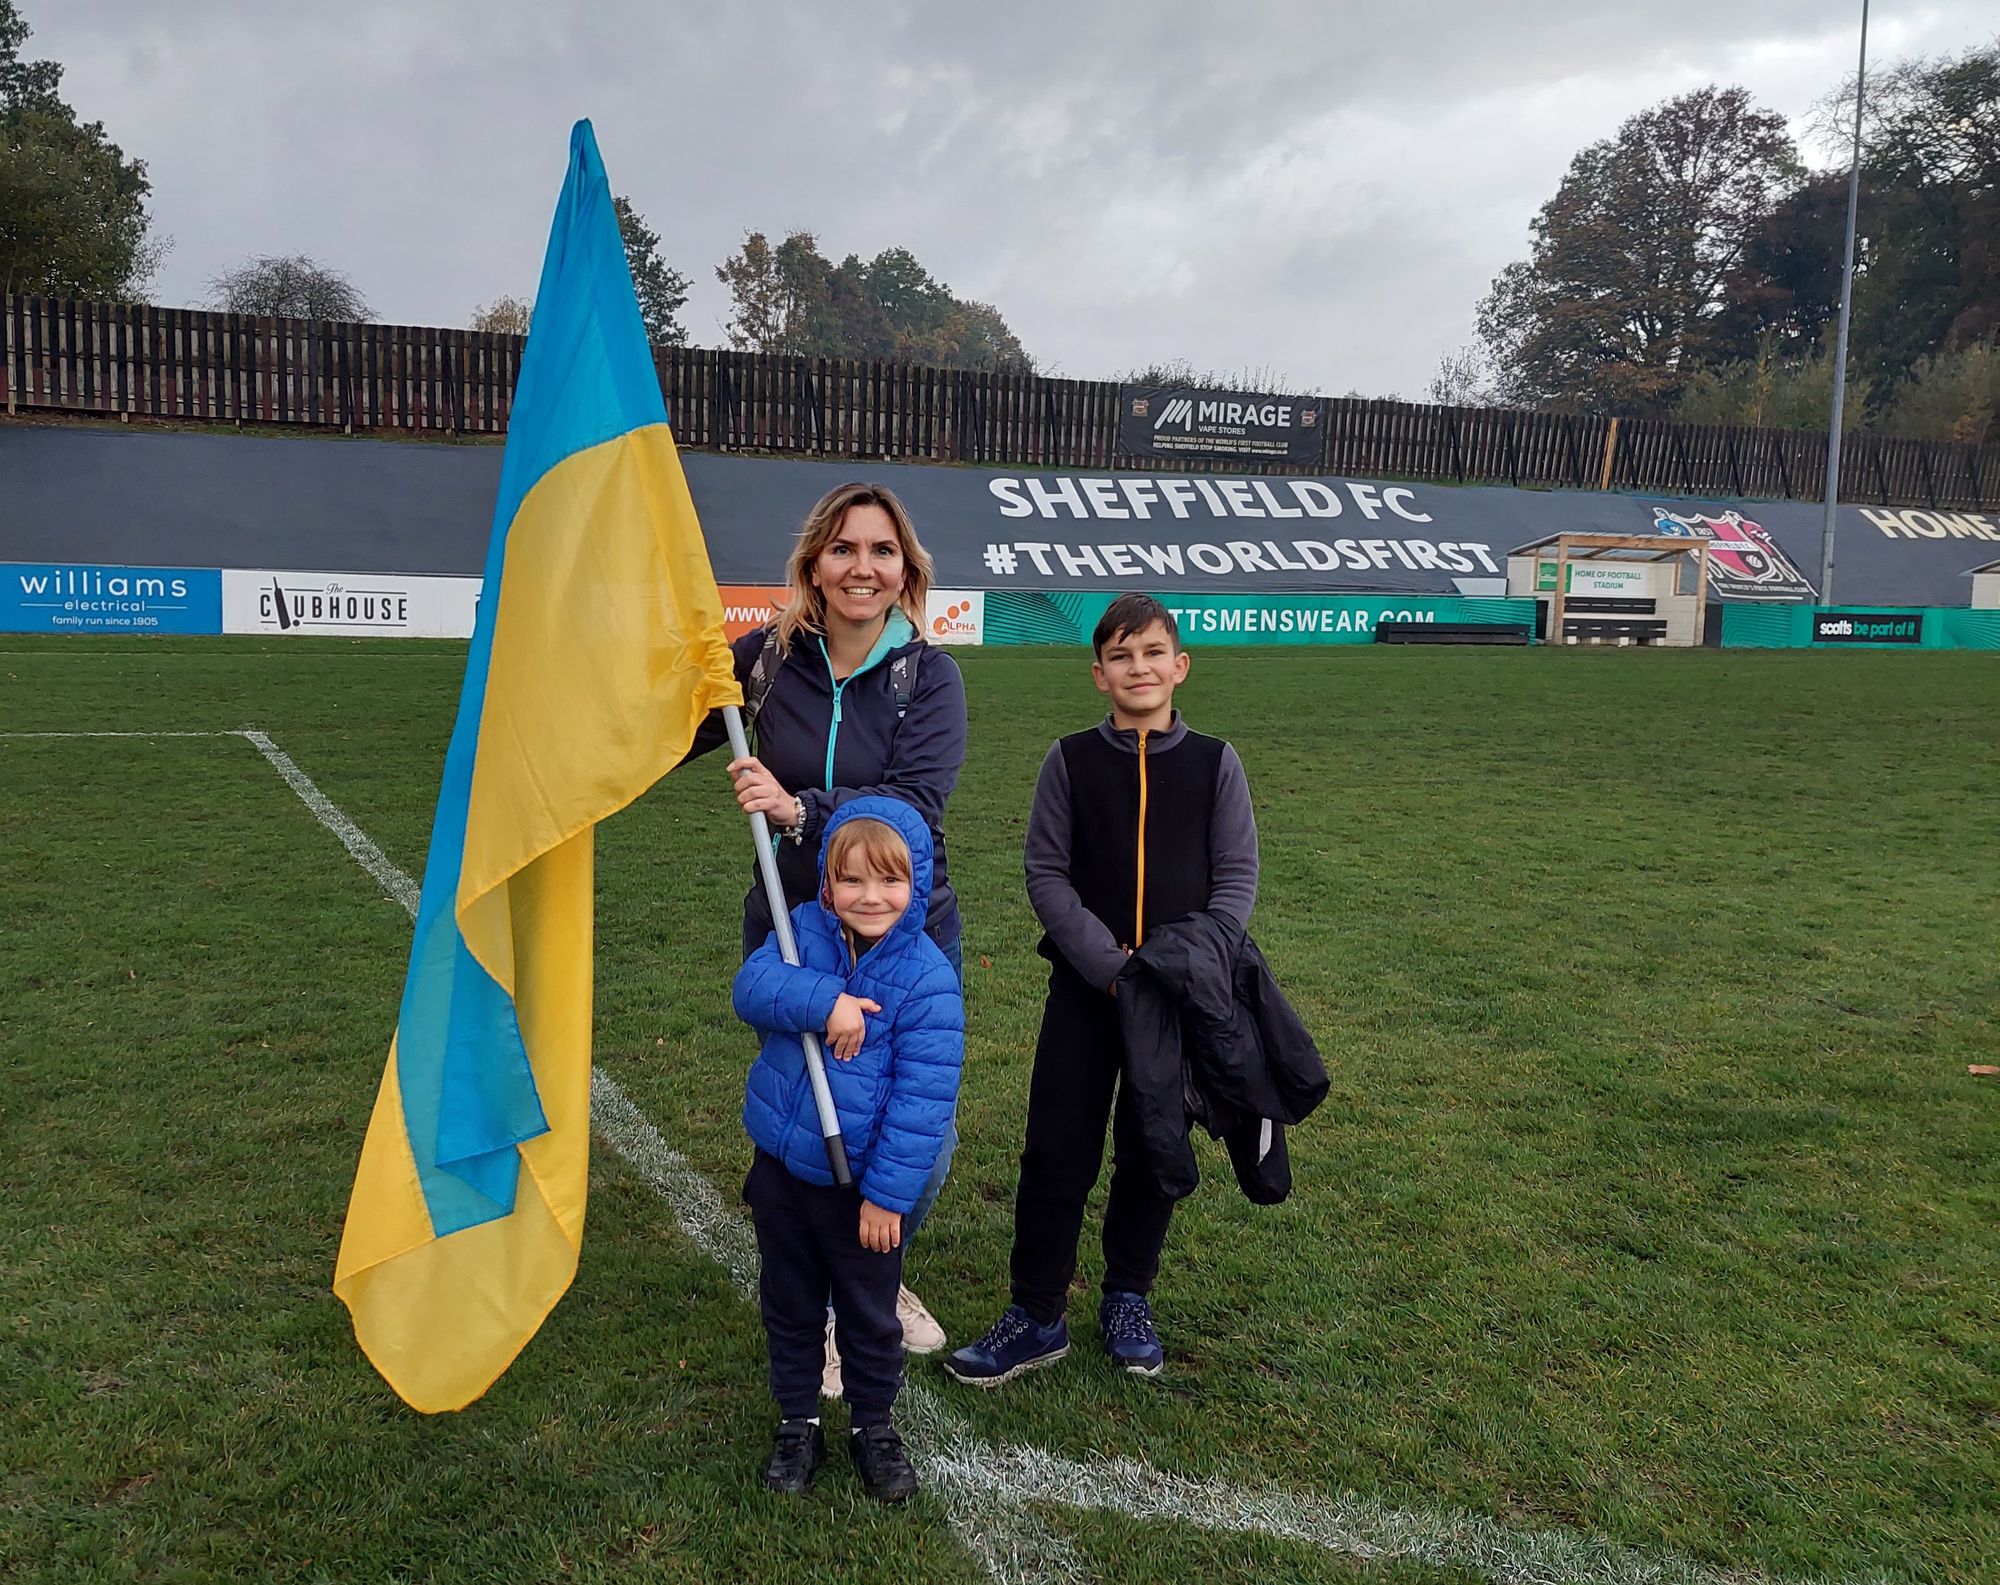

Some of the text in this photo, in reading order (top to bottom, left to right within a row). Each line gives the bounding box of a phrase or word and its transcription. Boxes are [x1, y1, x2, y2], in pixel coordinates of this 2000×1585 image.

[1198, 400, 1292, 427] MIRAGE
[1198, 425, 1246, 435] VAPE STORES
[988, 477, 1435, 523] SHEFFIELD FC
[982, 539, 1500, 577] #THEWORLDSFIRST
[1575, 570, 1595, 578] HOME
[1607, 571, 1642, 580] FOOTBALL
[19, 570, 188, 597] williams
[325, 583, 345, 595] The
[1593, 581, 1624, 589] STADIUM
[64, 599, 146, 612] electrical
[52, 615, 158, 626] family run since 1905
[940, 621, 977, 631] ALPHA
[1820, 620, 1915, 638] scotts be part of it
